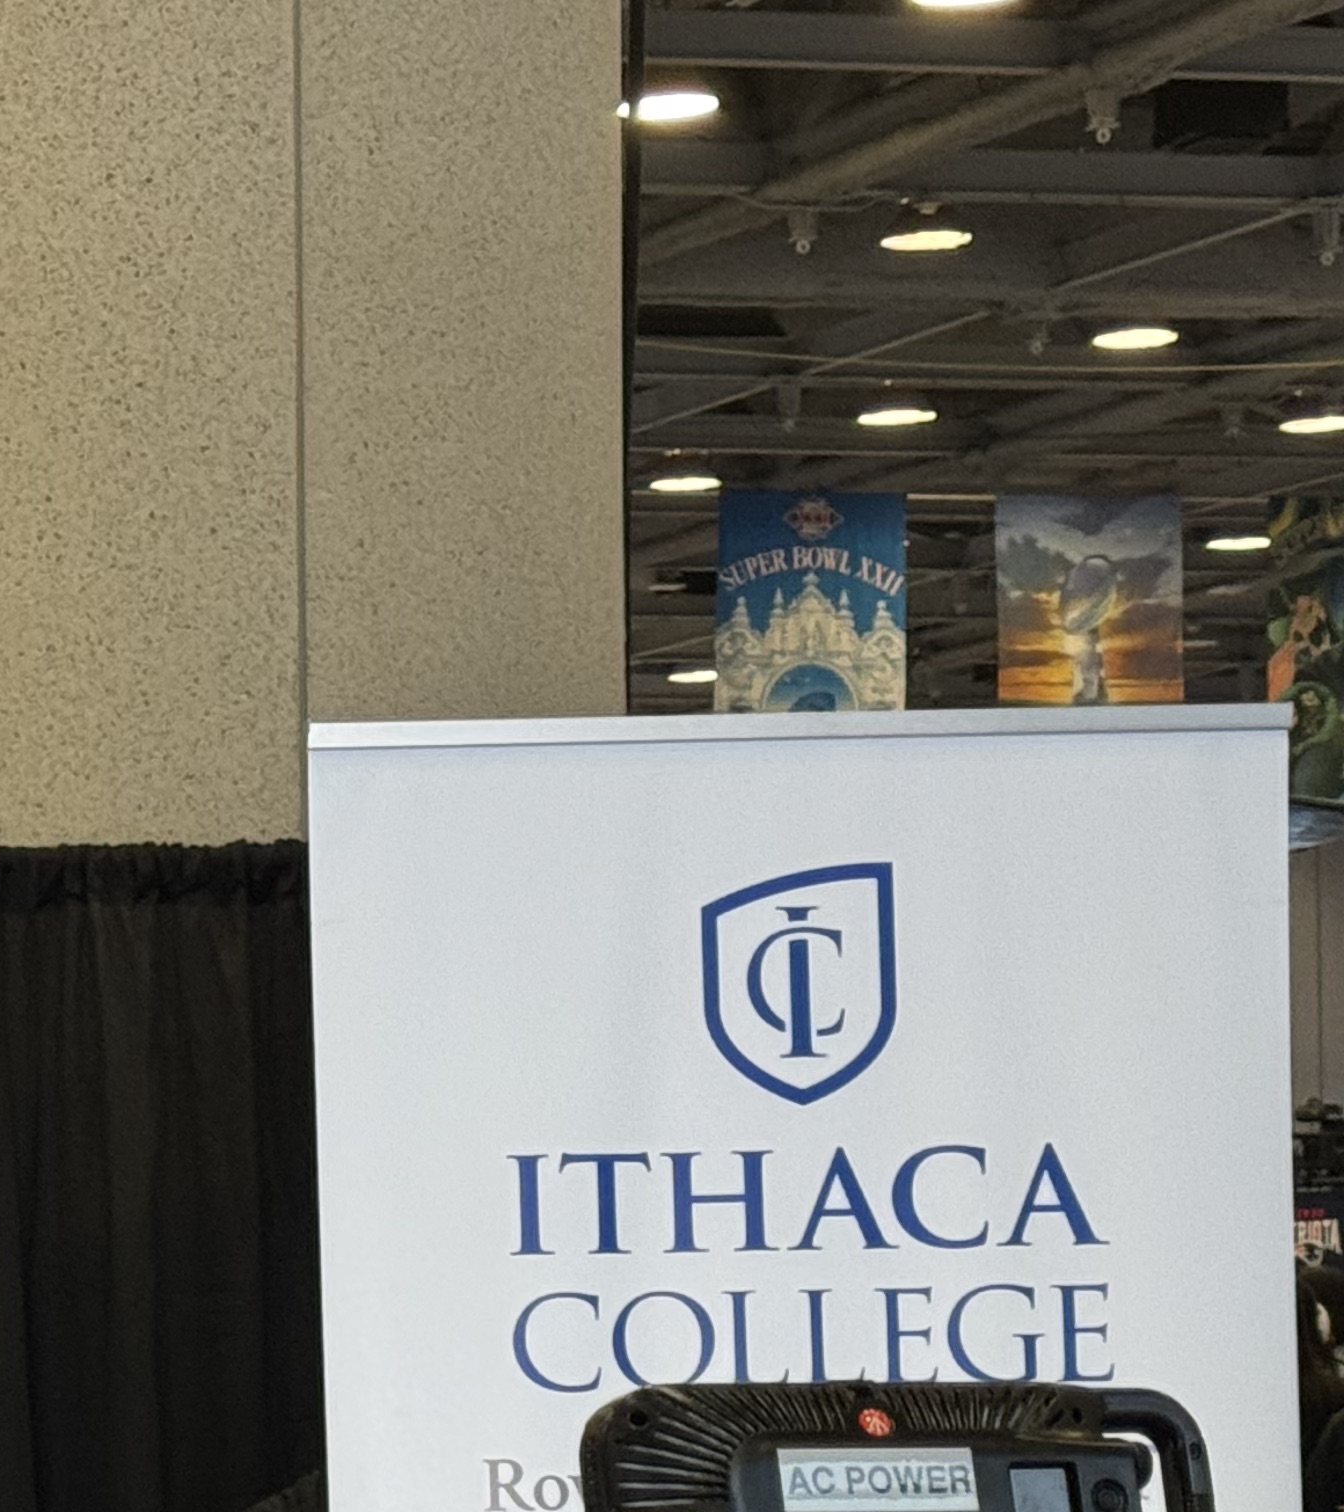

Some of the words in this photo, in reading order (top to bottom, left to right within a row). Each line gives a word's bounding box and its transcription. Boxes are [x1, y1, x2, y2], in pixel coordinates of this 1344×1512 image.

[717, 548, 788, 592] SUPER
[791, 545, 852, 576] BOWL
[854, 555, 906, 597] XXII
[506, 1141, 1112, 1257] ITHACA
[512, 1282, 1116, 1394] COLLEGE
[788, 1465, 837, 1495] AC
[845, 1464, 973, 1494] POWER
